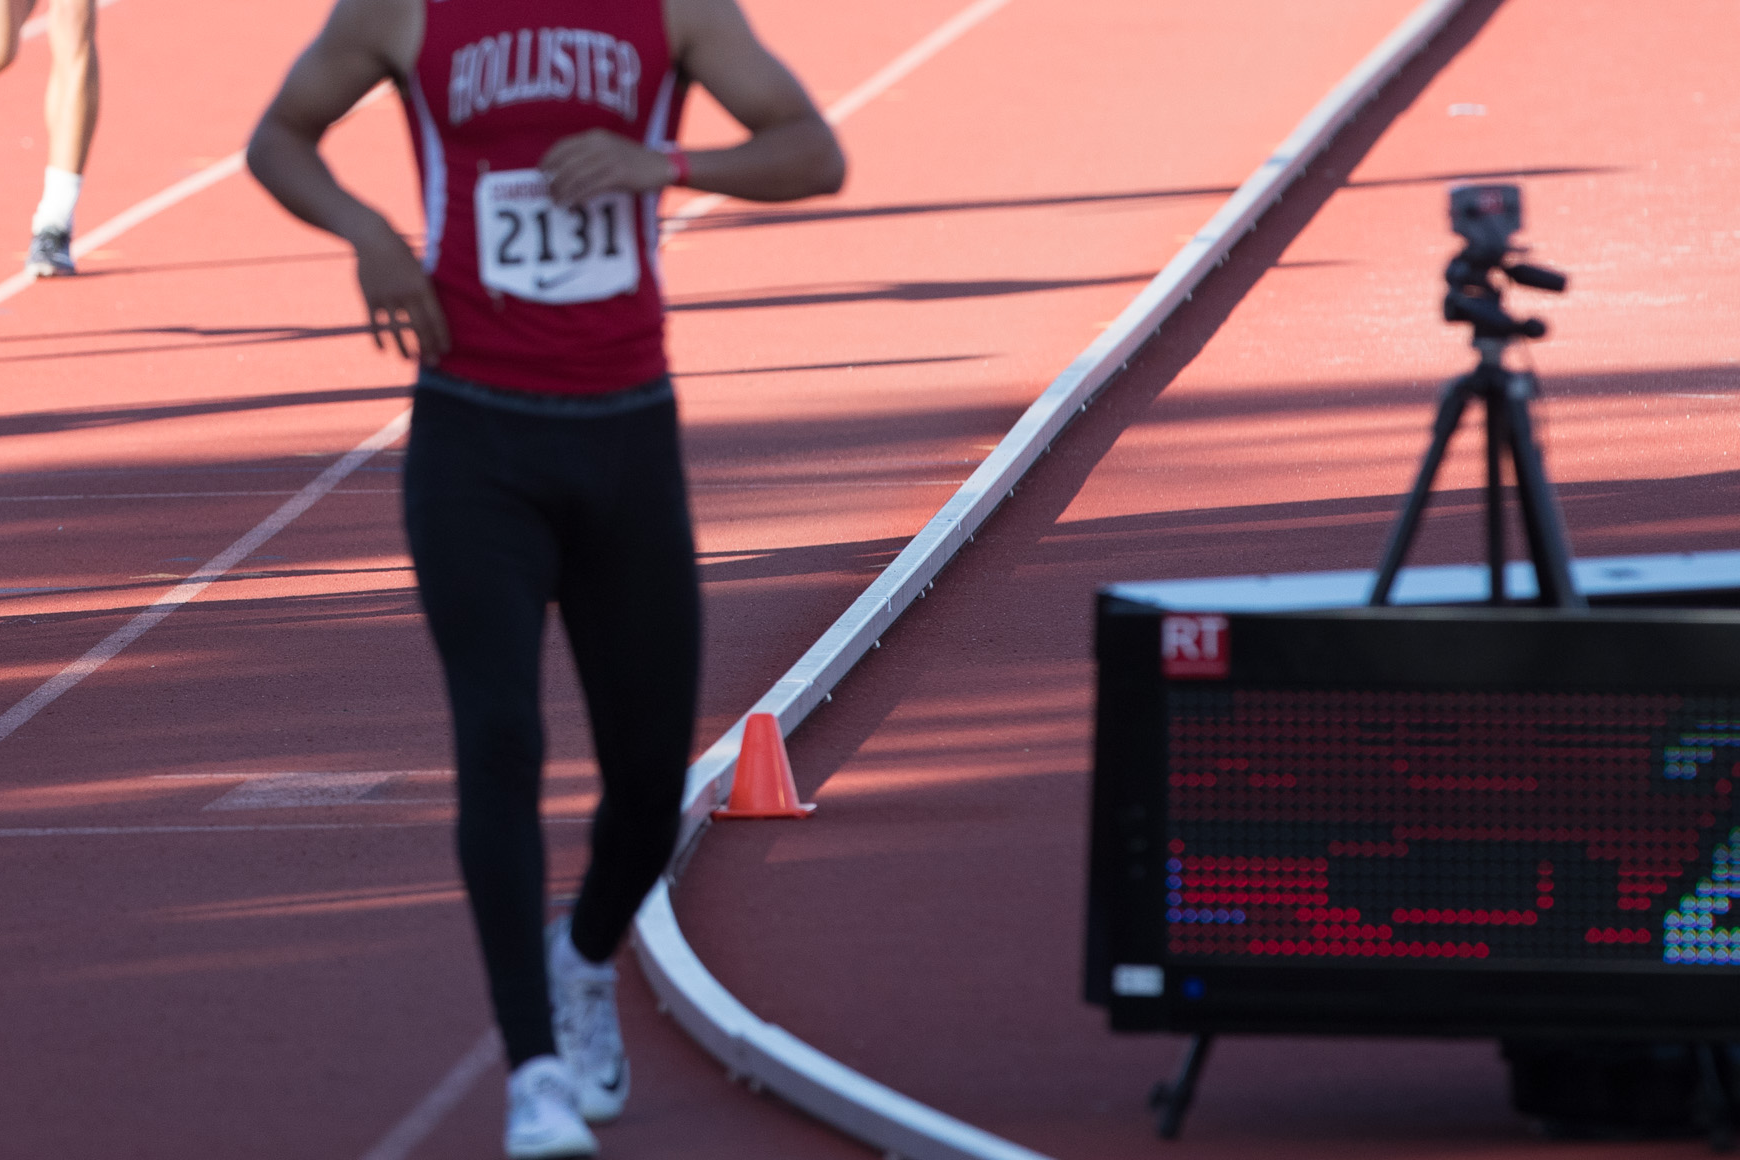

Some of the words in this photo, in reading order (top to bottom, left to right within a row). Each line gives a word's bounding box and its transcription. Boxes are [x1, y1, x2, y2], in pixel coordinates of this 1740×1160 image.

[448, 27, 642, 126] HOLLISTER
[496, 203, 619, 264] 2131
[1162, 615, 1229, 660] RT
